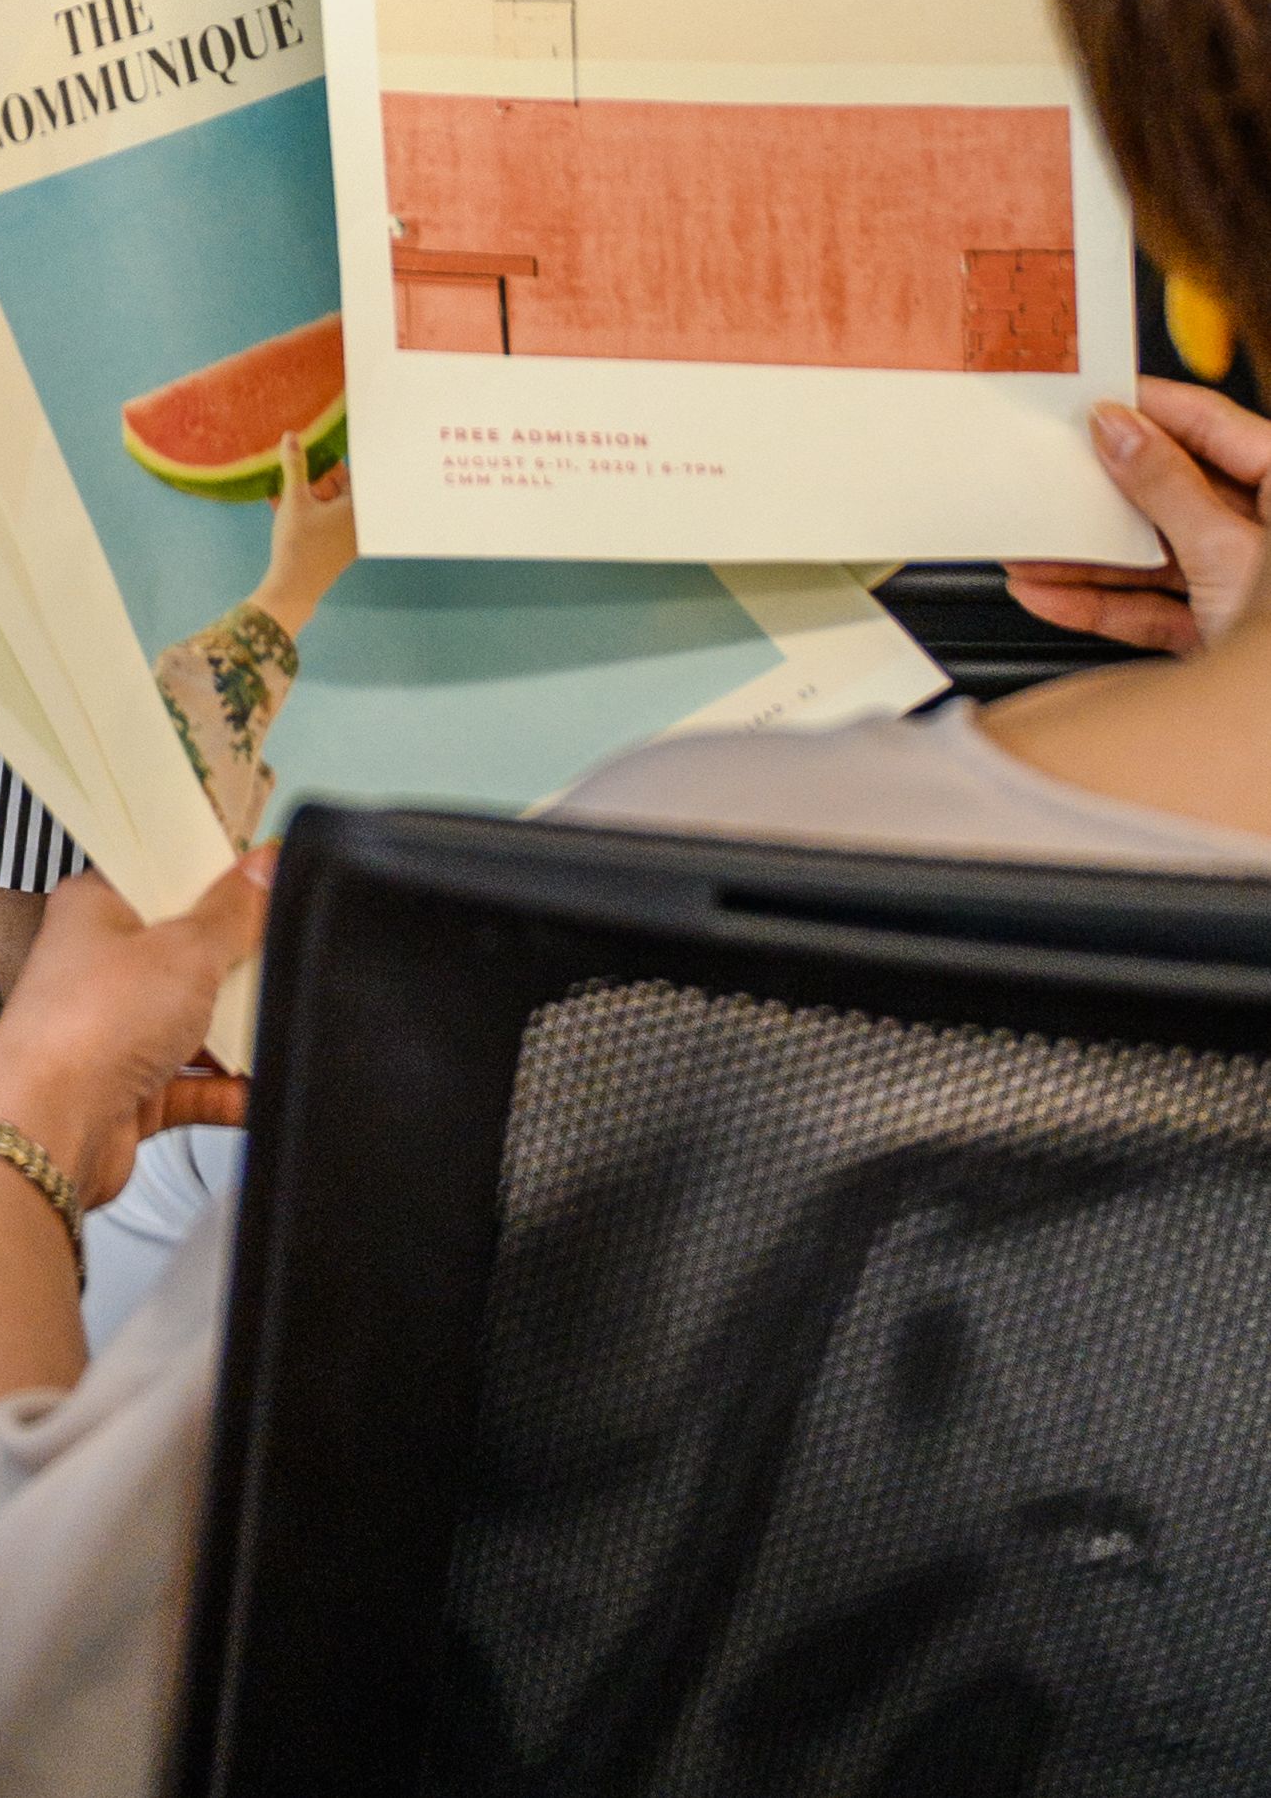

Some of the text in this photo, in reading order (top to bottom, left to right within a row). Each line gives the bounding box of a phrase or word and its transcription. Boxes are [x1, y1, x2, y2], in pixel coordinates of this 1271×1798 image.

[439, 426, 649, 447] FREE ADMISSION
[442, 454, 526, 469] AUGUST
[501, 472, 554, 487] HALL
